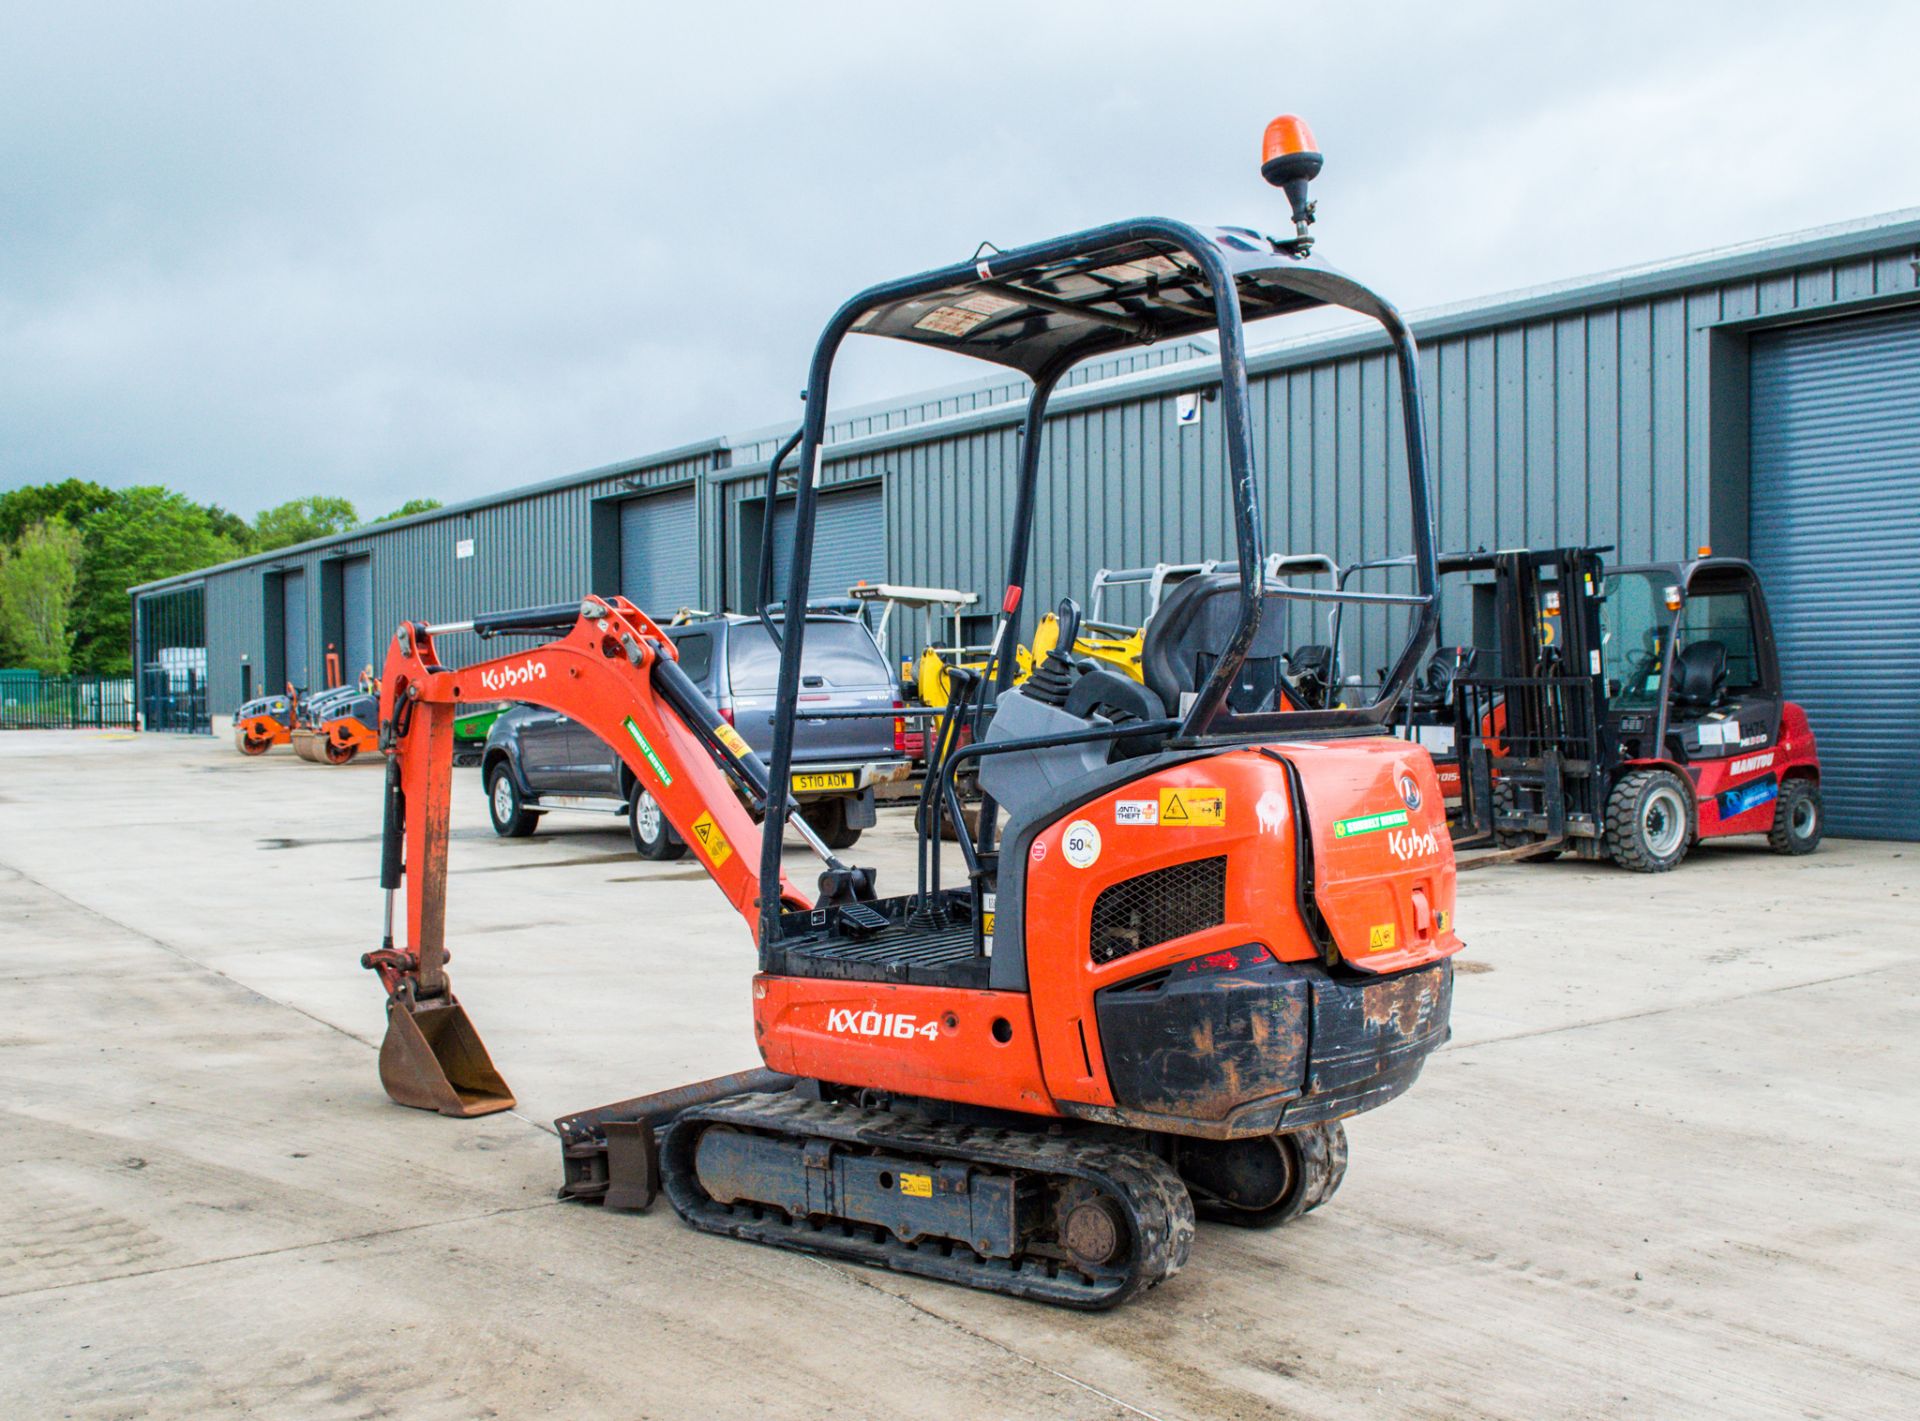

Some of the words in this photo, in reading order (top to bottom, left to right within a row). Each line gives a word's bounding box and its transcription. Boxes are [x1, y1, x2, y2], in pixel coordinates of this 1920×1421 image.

[481, 659, 547, 691] Kubota
[1729, 752, 1775, 777] MANITOU
[1117, 812, 1141, 820] THEFT
[827, 1007, 939, 1041] KX016-4
